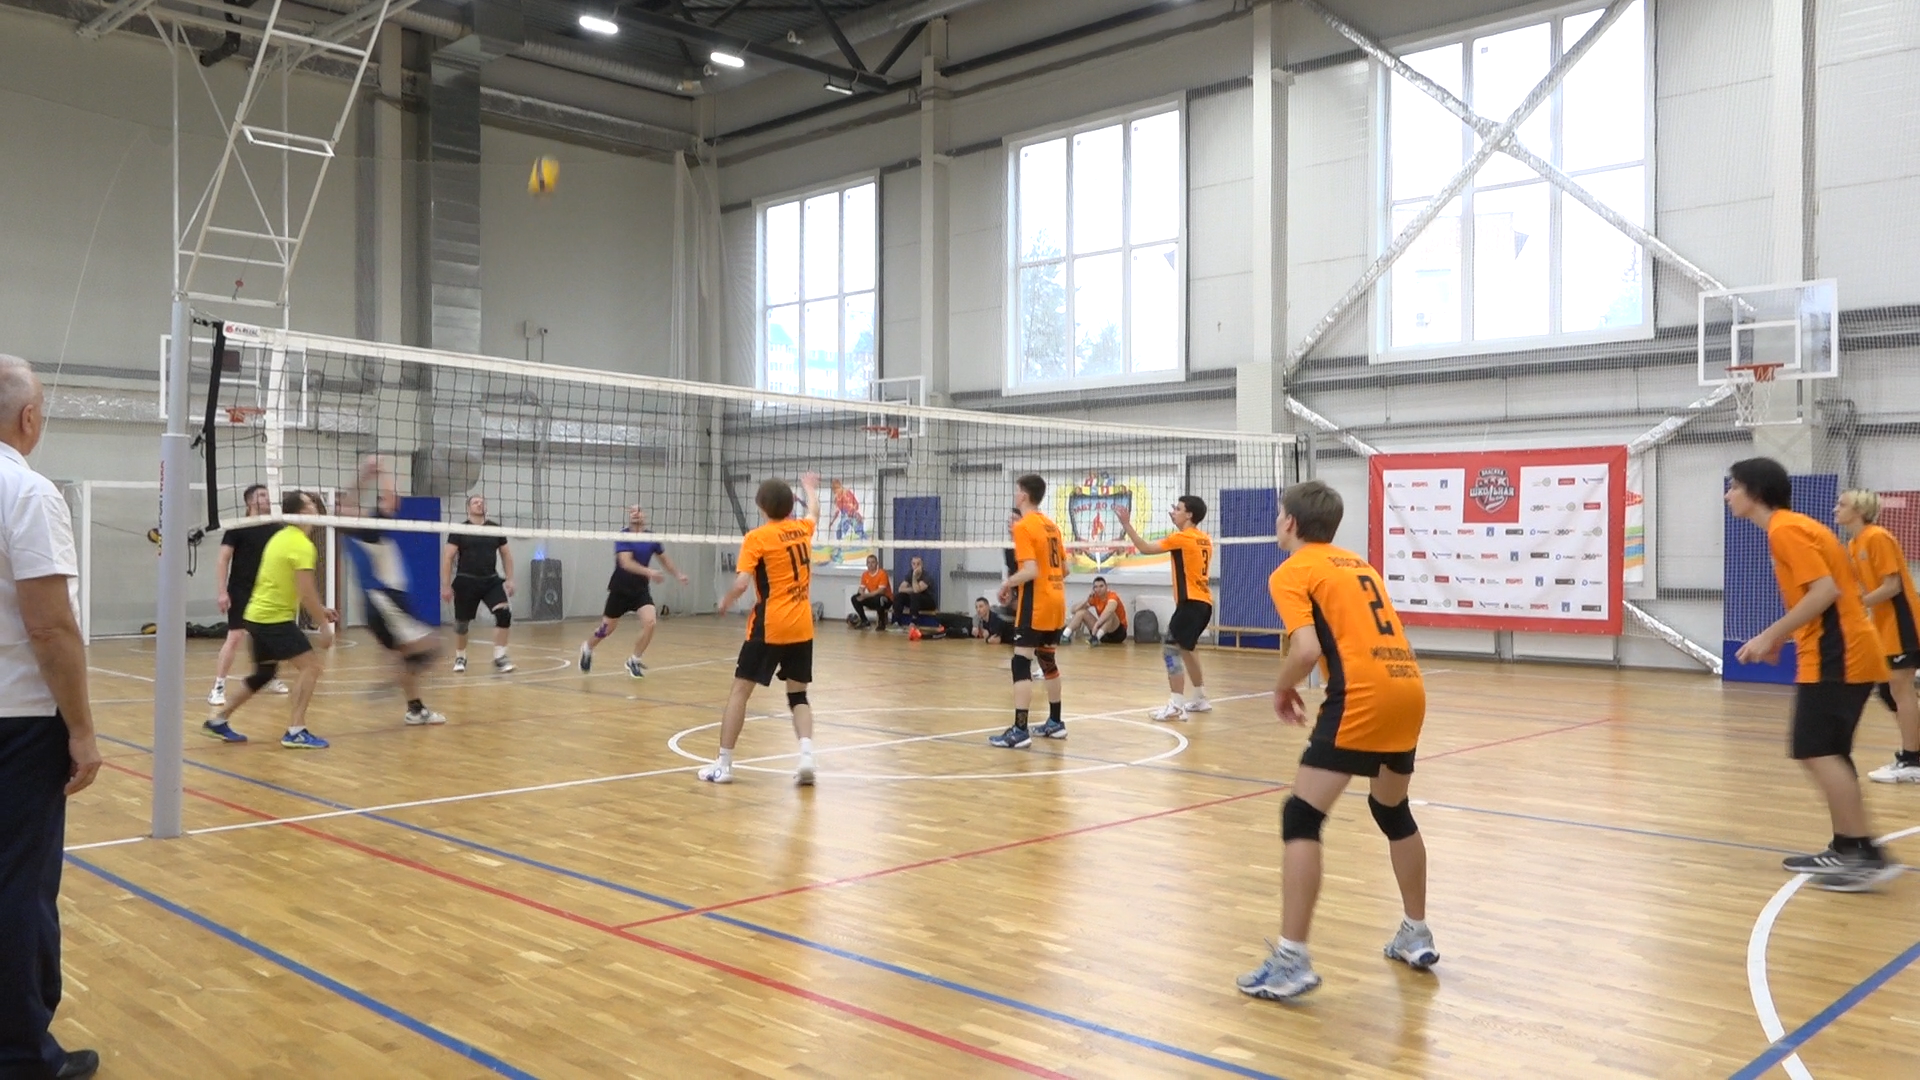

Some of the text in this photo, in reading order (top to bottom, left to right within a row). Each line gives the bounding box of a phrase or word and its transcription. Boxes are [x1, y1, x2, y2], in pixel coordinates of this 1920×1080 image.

[786, 542, 811, 581] 14
[1201, 549, 1209, 576] 3
[1357, 575, 1395, 637] 2
